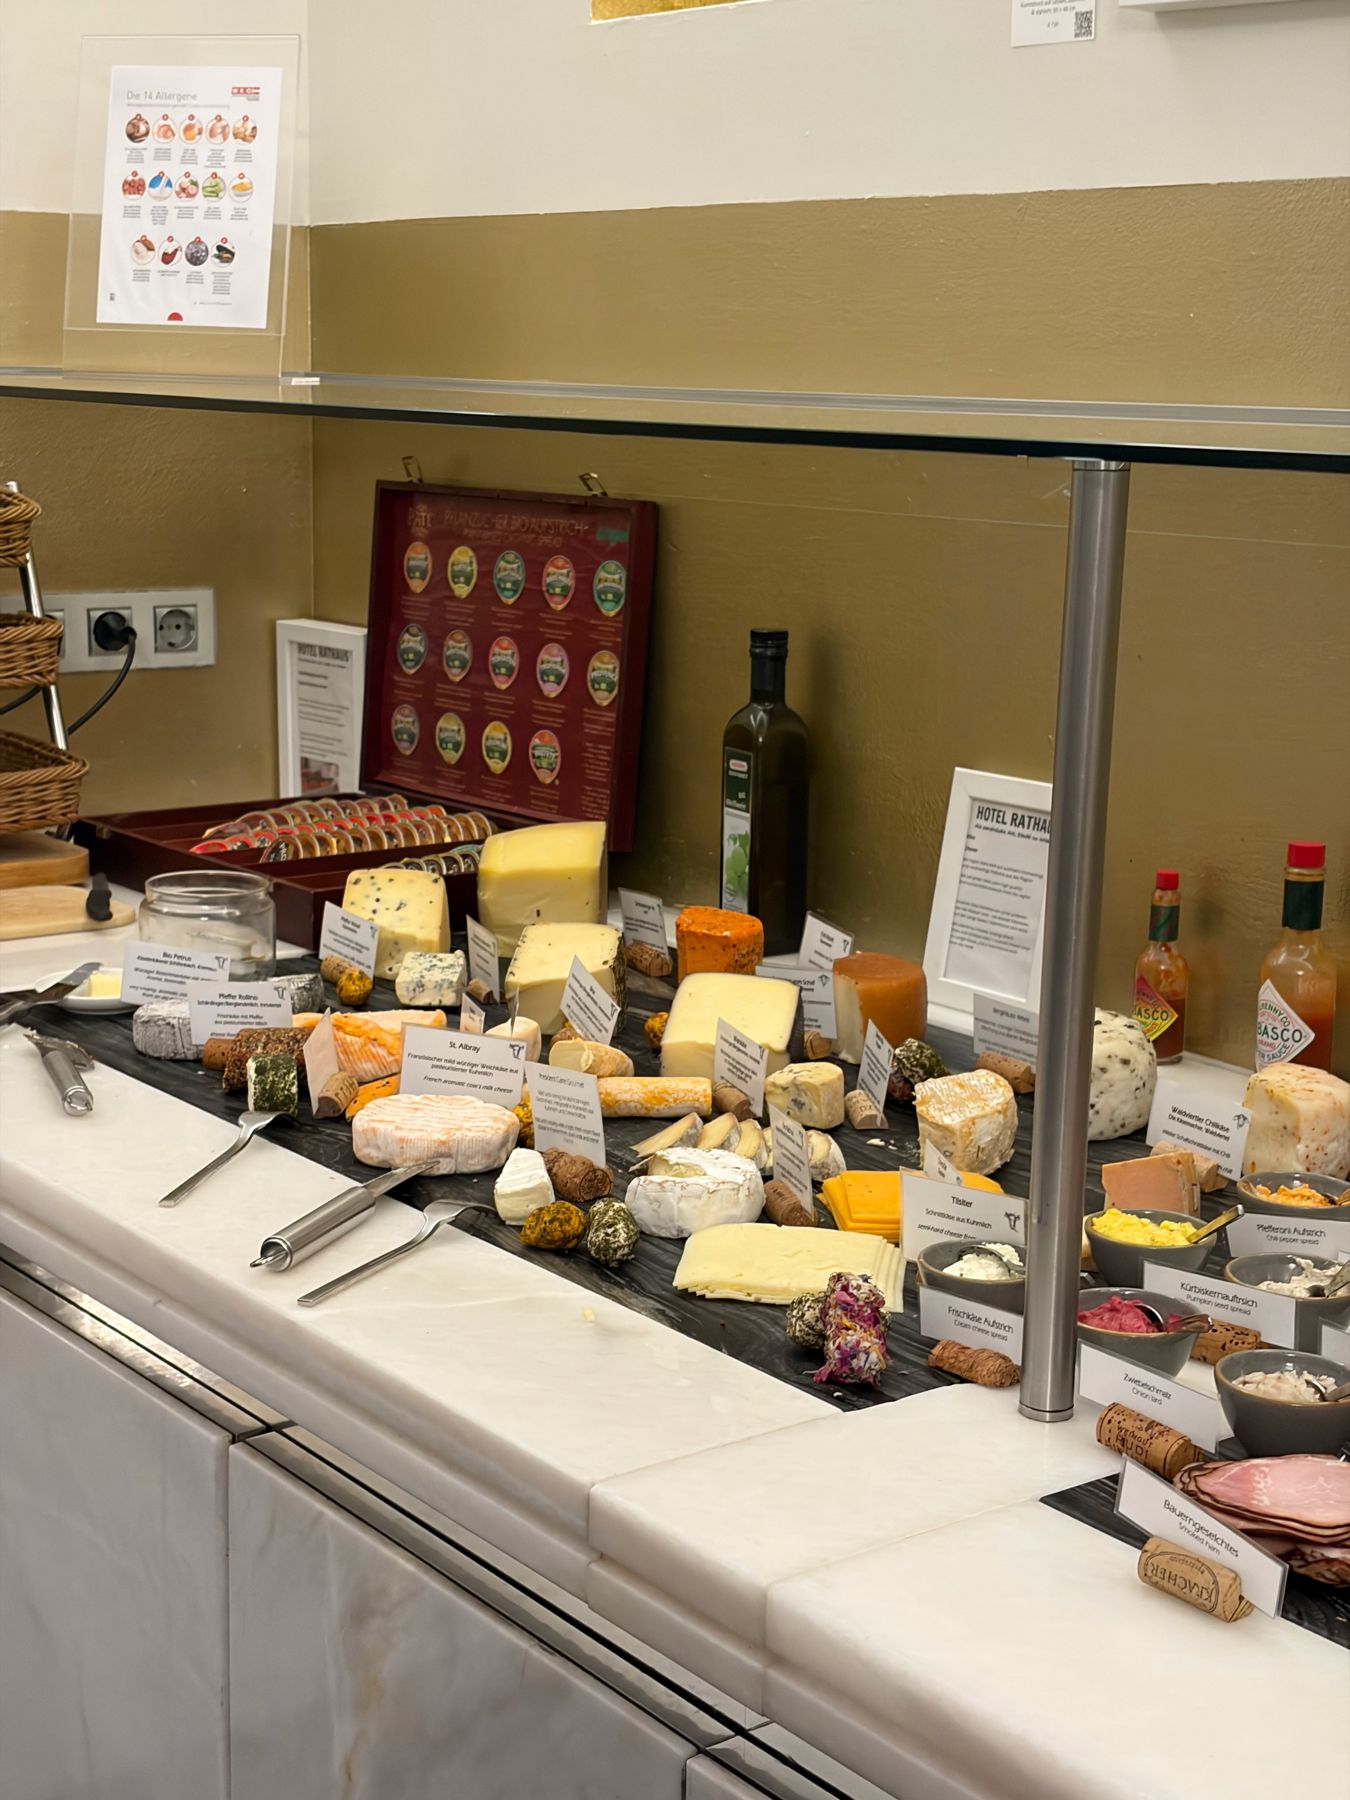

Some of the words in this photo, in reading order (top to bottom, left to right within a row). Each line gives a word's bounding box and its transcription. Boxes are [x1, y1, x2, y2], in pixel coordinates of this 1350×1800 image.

[127, 90, 141, 100] Die
[144, 91, 154, 100] 14
[155, 91, 197, 102] Allergene
[976, 805, 1007, 825] HOTEL
[174, 954, 192, 962] Petrus
[458, 1042, 480, 1054] Albray
[1266, 1044, 1290, 1061] SAUCE
[408, 1052, 442, 1062] Französischer
[456, 1060, 479, 1069] würziger
[480, 1064, 508, 1072] Weichkäse
[468, 1068, 494, 1077] Kuhmilch
[424, 1076, 442, 1084] French
[442, 1079, 465, 1087] aromatic
[466, 1082, 481, 1090] cow's
[494, 1086, 514, 1094] cheese
[1171, 1106, 1204, 1124] Waldviertler
[951, 1196, 973, 1208] Tilsiter
[925, 1208, 956, 1221] Schnittkäse
[956, 1216, 966, 1224] aus
[966, 1218, 992, 1230] Kuhmilch
[917, 1223, 944, 1234] semi-hard
[944, 1230, 963, 1239] cheese
[1256, 1224, 1292, 1234] Pfefferoni
[1292, 1228, 1326, 1238] Aufstrich
[1186, 1294, 1213, 1306] Pumpkin
[1214, 1301, 1229, 1310] seed
[1230, 1306, 1252, 1316] spread
[948, 1306, 982, 1324] Frischkäse
[984, 1316, 1014, 1334] Aufstrich
[954, 1318, 972, 1330] Cream
[972, 1324, 990, 1336] cheese
[990, 1330, 1008, 1342] spread
[1132, 1387, 1150, 1400] Onion
[1151, 1394, 1163, 1405] lard
[1163, 1499, 1240, 1558] Bauerngeselchtes
[1178, 1521, 1204, 1544] Smoked
[1204, 1540, 1221, 1556] ham
[1150, 1562, 1213, 1604] KRACHER
